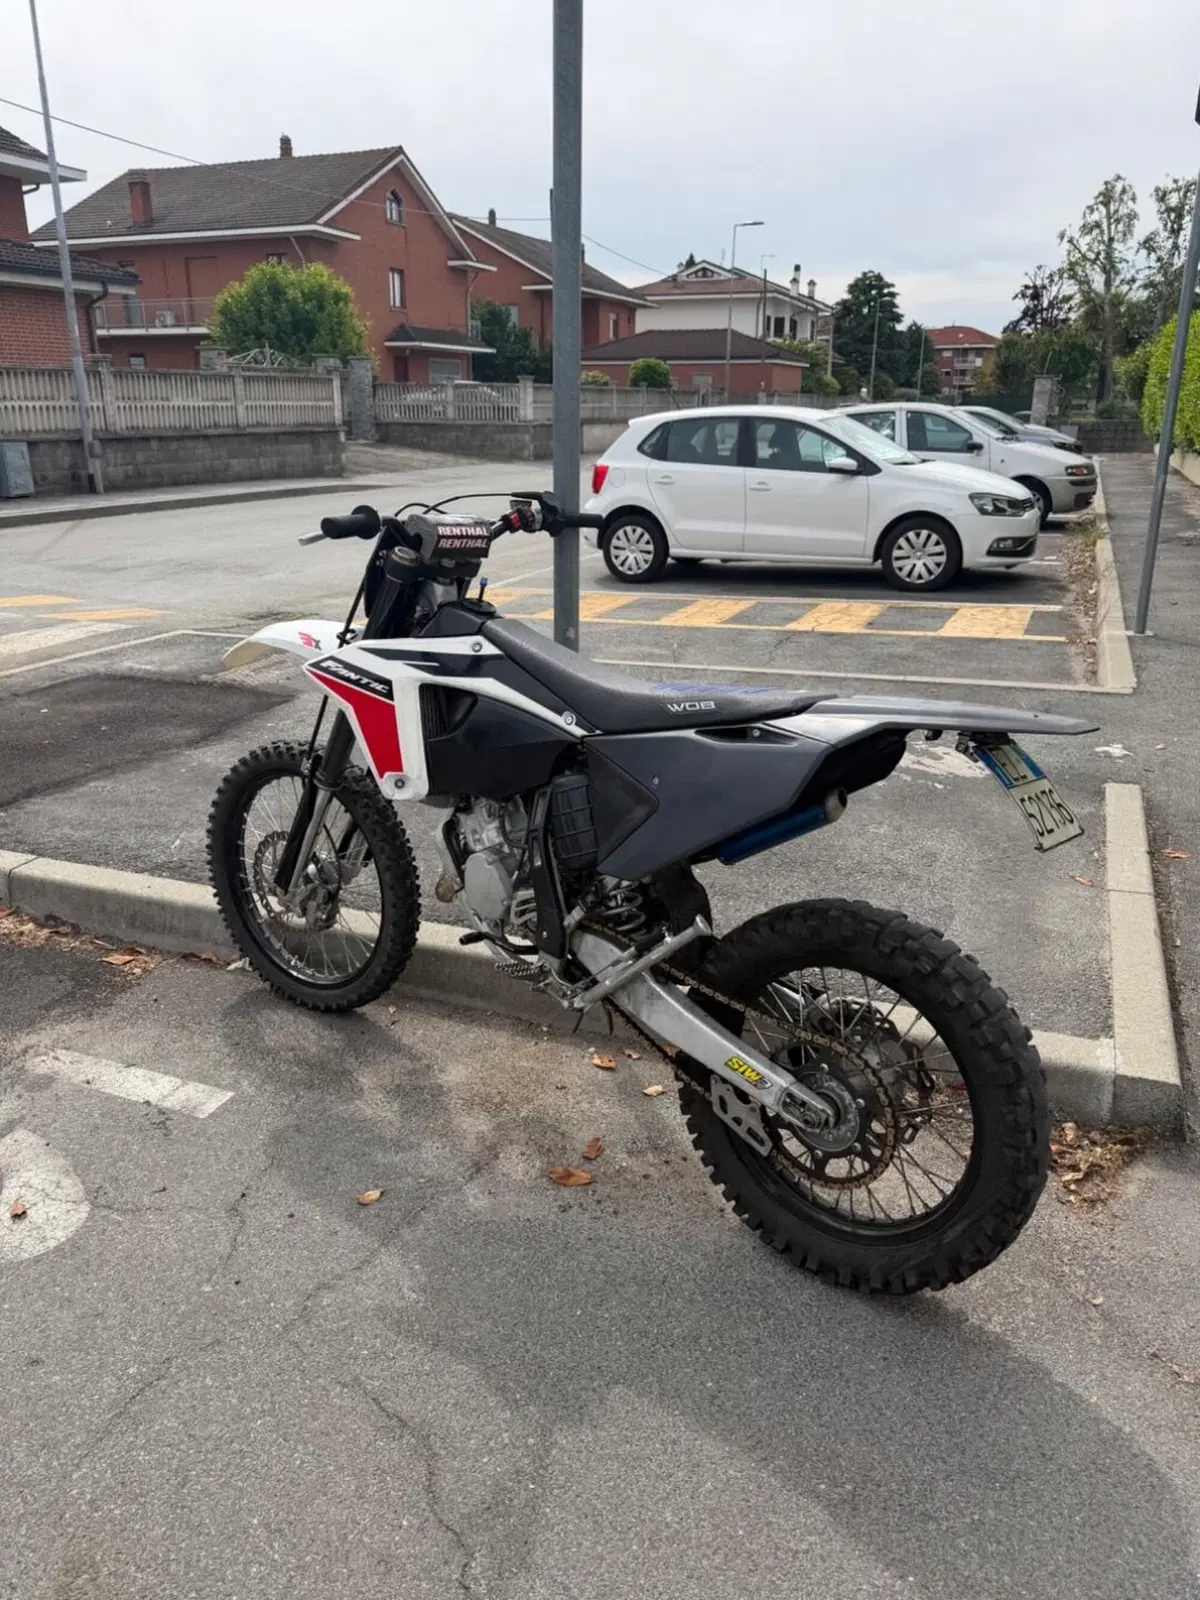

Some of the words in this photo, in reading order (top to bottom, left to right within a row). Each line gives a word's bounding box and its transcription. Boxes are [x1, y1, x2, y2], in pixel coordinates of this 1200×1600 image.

[438, 525, 490, 537] RENTHAL
[438, 538, 488, 548] RENTHAL
[320, 660, 390, 693] FANTIC
[1019, 787, 1075, 837] 52136
